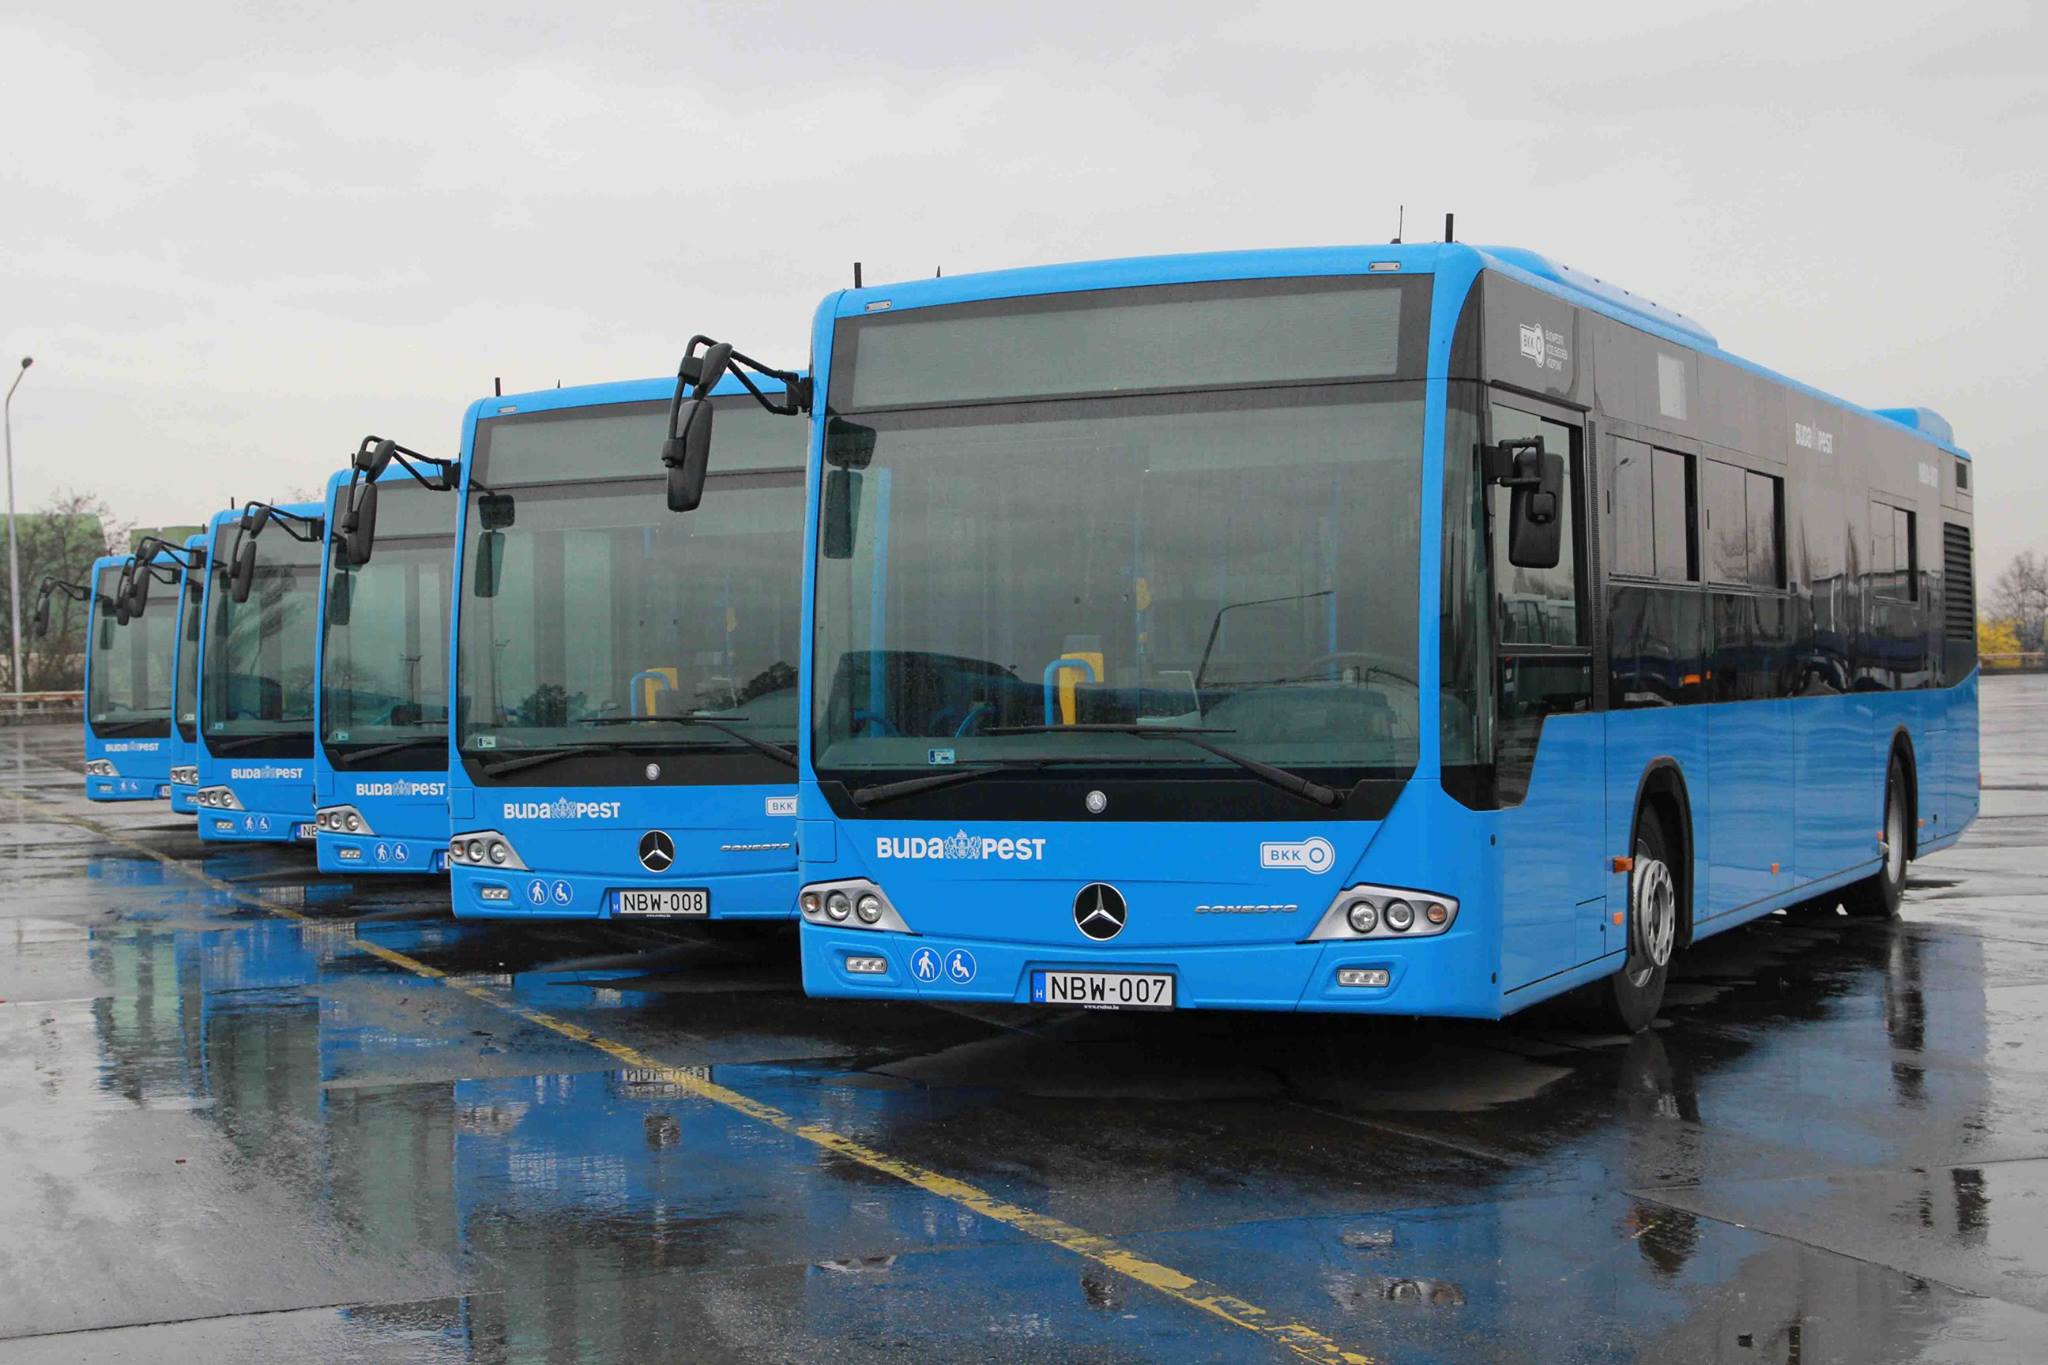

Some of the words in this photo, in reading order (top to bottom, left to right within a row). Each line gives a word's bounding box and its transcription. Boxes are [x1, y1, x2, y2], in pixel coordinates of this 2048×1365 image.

[772, 802, 794, 811] BKK
[1270, 850, 1301, 861] BKK
[623, 893, 703, 911] NBW-008
[1195, 904, 1299, 914] CONECTO
[1035, 989, 1043, 999] H
[1051, 975, 1167, 1004] NBW-007
